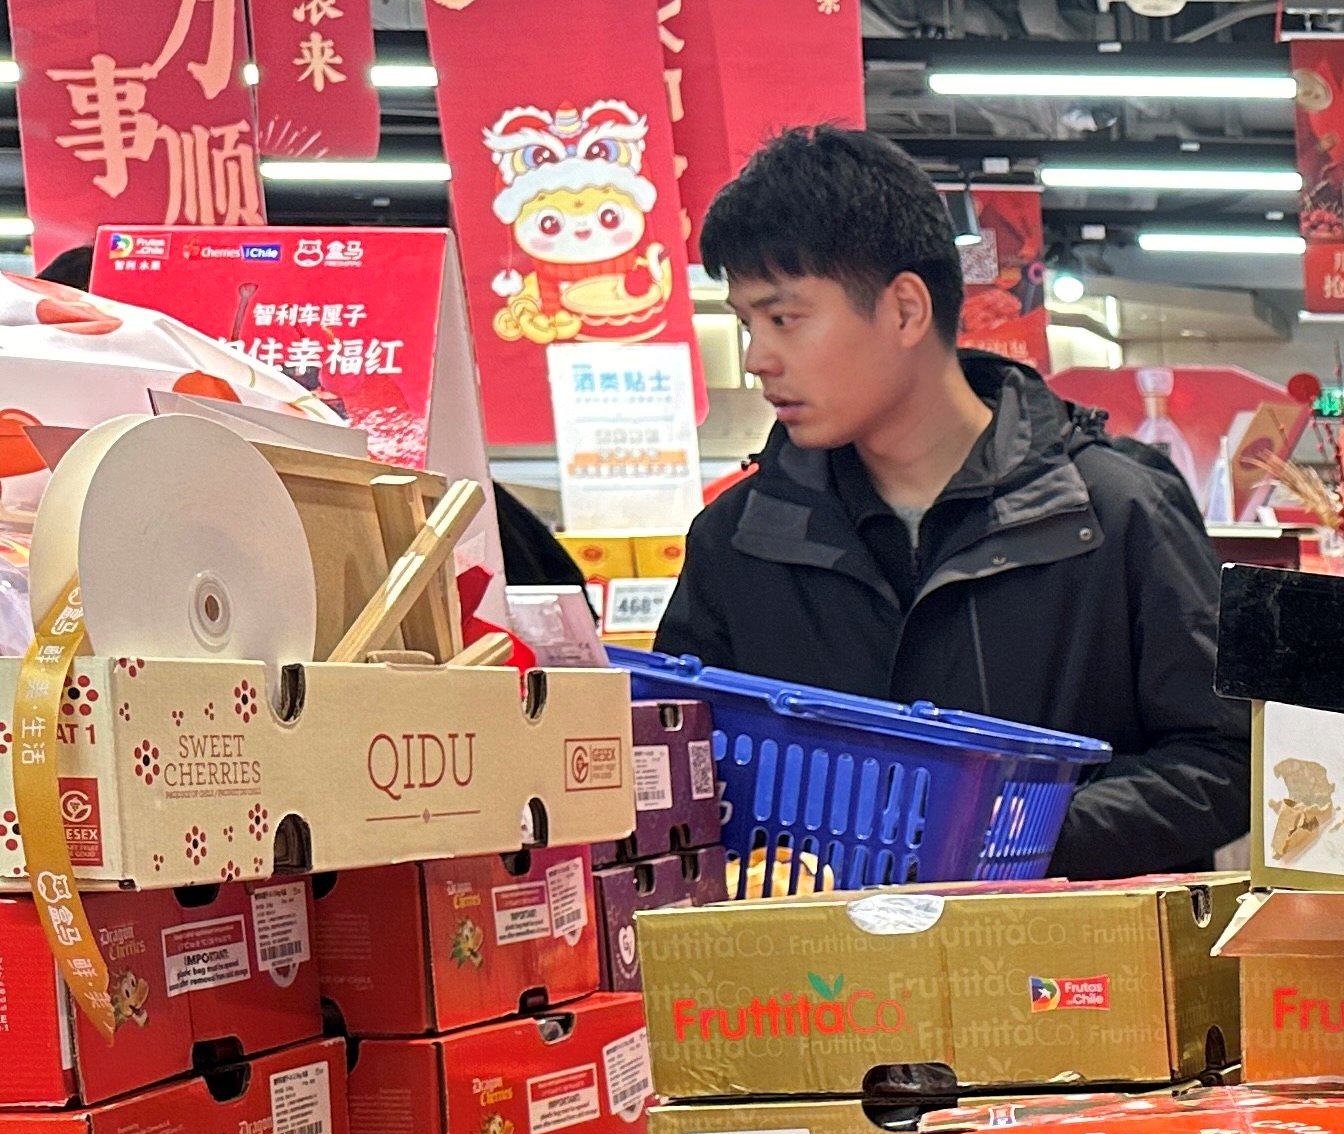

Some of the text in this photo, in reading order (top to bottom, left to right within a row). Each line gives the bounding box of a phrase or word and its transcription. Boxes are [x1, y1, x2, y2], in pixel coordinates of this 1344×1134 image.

[253, 304, 367, 327] 智利车厘子
[56, 724, 96, 744] AT 1
[179, 734, 245, 758] SWEET
[164, 762, 261, 787] CHERRIES
[367, 733, 476, 800] QIDU
[1064, 981, 1103, 993] Frutas
[1073, 994, 1104, 1005] Chile
